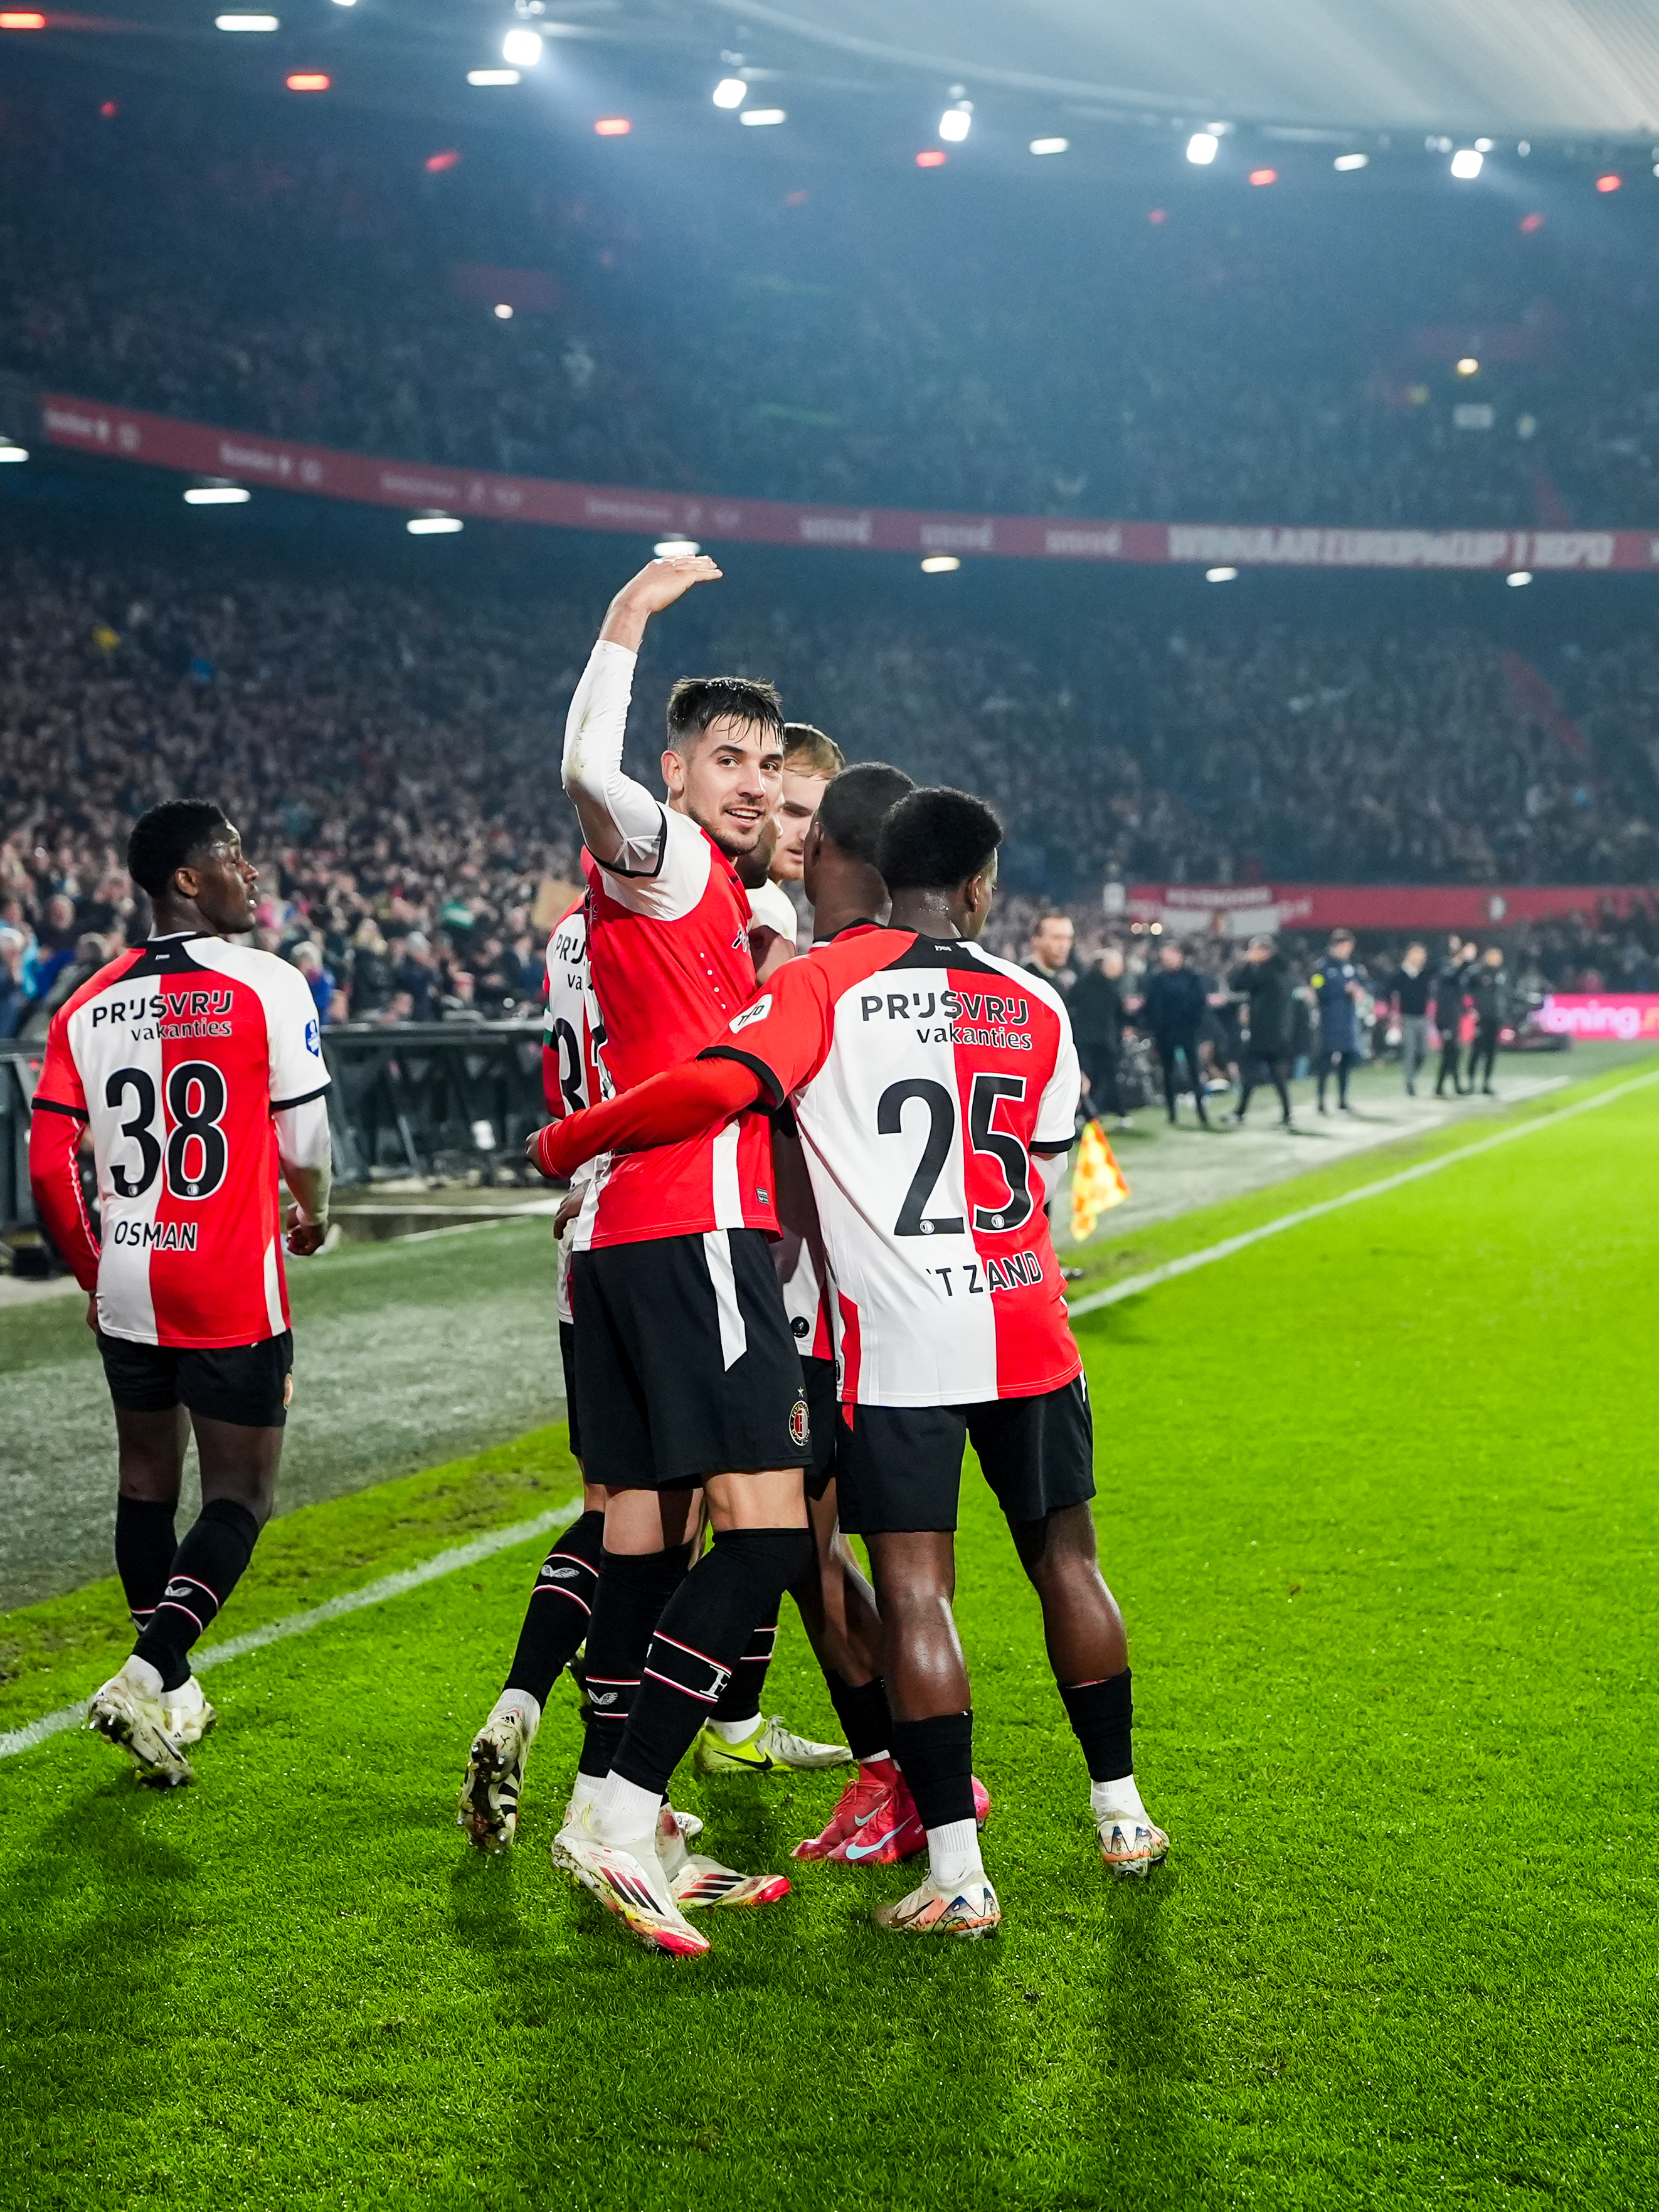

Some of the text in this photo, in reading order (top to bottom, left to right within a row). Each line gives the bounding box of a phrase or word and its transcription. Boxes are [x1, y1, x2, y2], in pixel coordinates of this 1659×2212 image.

[92, 990, 234, 1028] PRIJSVRIJ
[861, 990, 1030, 1026] PRIJSVRIJ
[130, 1015, 234, 1042] vakanties
[916, 1022, 1034, 1051] vakanties
[105, 1059, 229, 1201] 38
[876, 1071, 1034, 1237] 25
[114, 1220, 198, 1251] OSMAN
[962, 1250, 1044, 1294] ZAND
